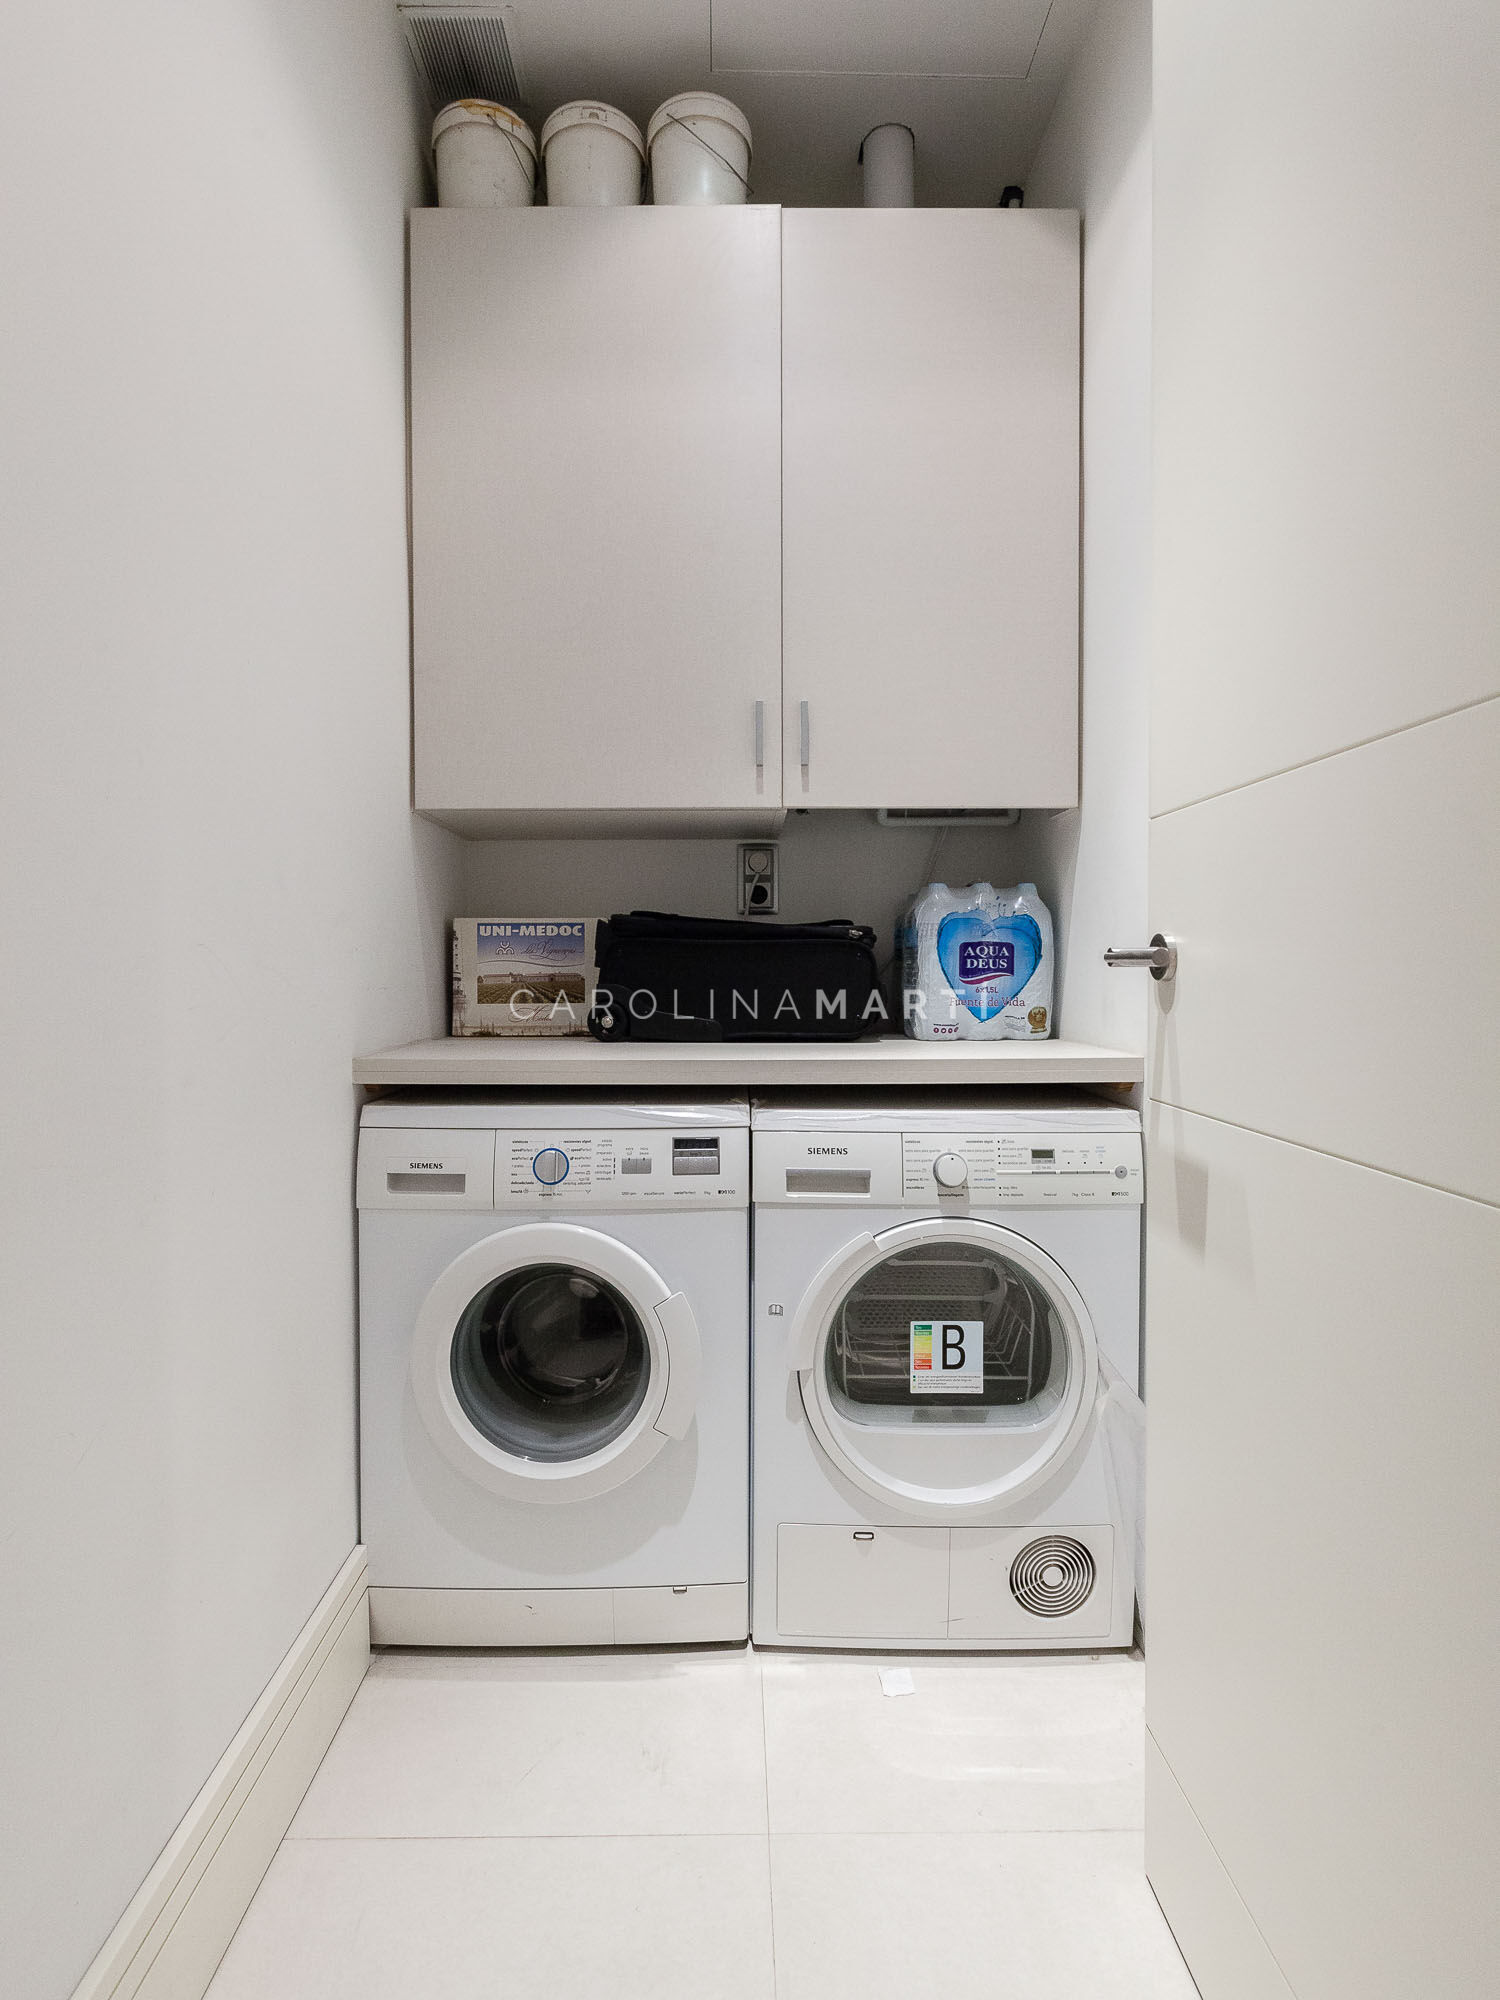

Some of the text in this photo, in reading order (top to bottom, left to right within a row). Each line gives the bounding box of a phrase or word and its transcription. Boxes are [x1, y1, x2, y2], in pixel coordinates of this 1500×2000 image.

[479, 925, 583, 937] UNI-MEDOC
[964, 945, 1010, 958] AQUA
[966, 958, 1008, 969] DEUS
[949, 996, 1026, 1007] Fuente de Vida
[807, 1147, 849, 1155] SIEMENS
[409, 1162, 444, 1170] SIEMENS
[941, 1324, 966, 1370] B
